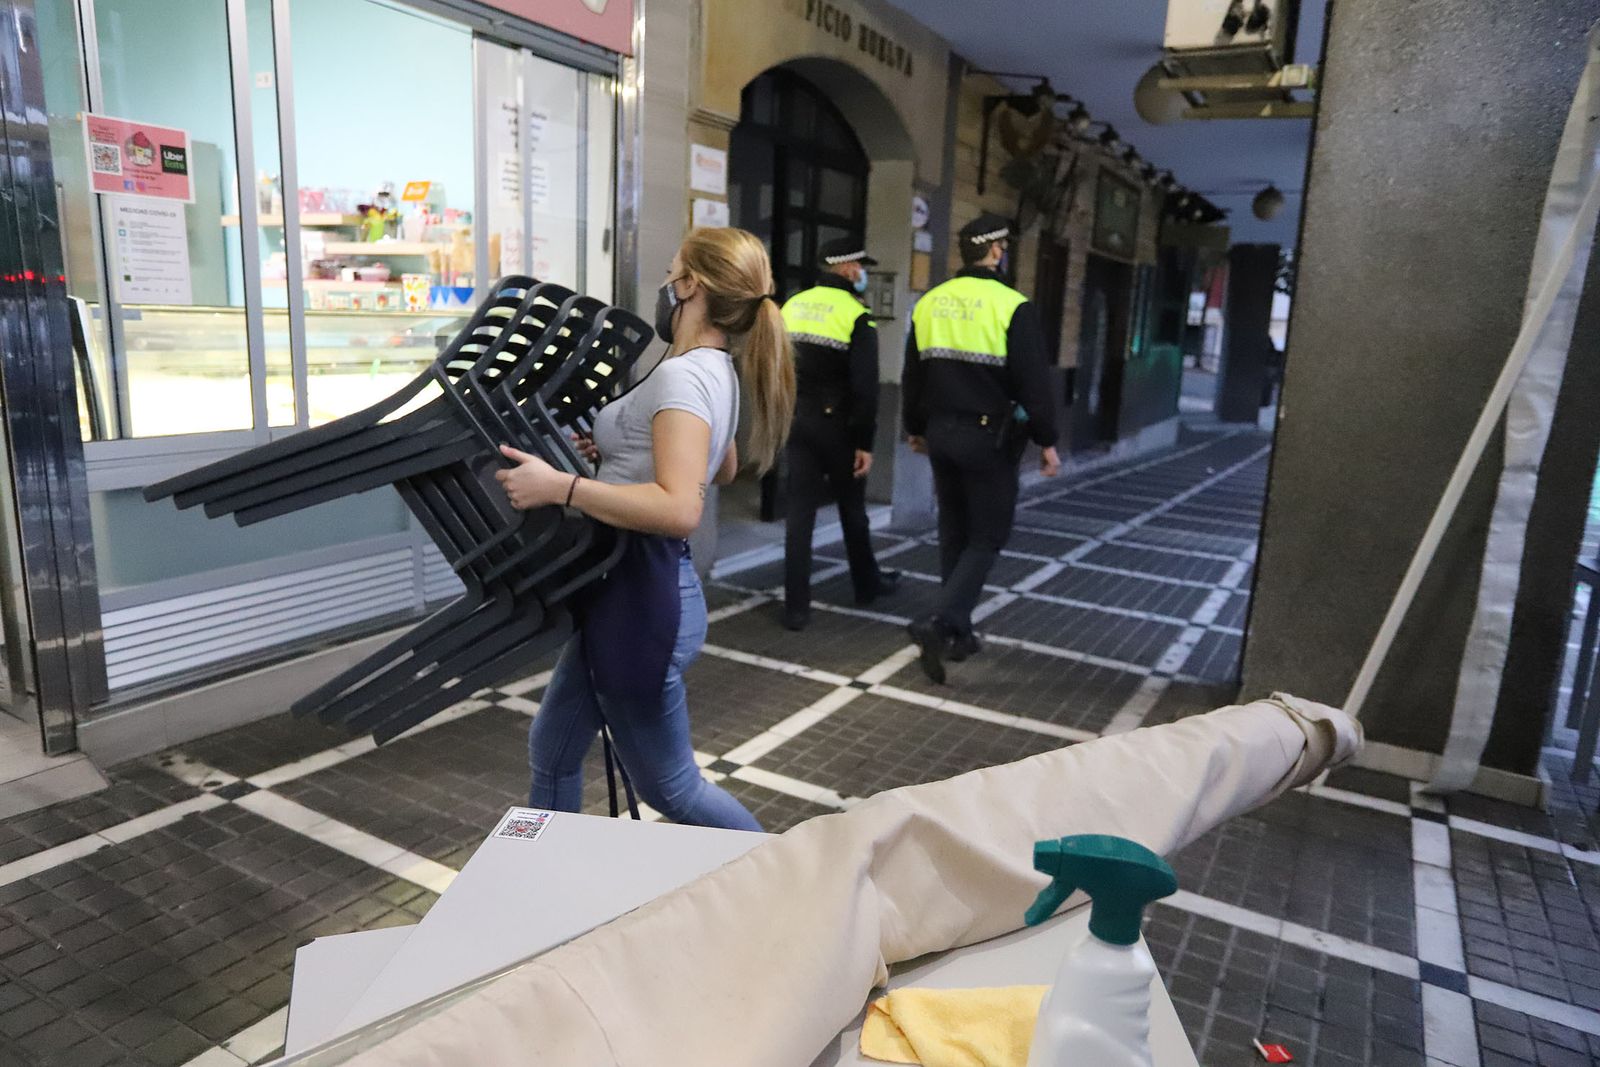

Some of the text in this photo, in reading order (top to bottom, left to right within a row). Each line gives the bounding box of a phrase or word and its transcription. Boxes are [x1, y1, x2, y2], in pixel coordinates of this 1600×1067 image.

[163, 151, 184, 161] Uber
[120, 207, 148, 215] MEDIDAS
[932, 308, 975, 321] LOCAL
